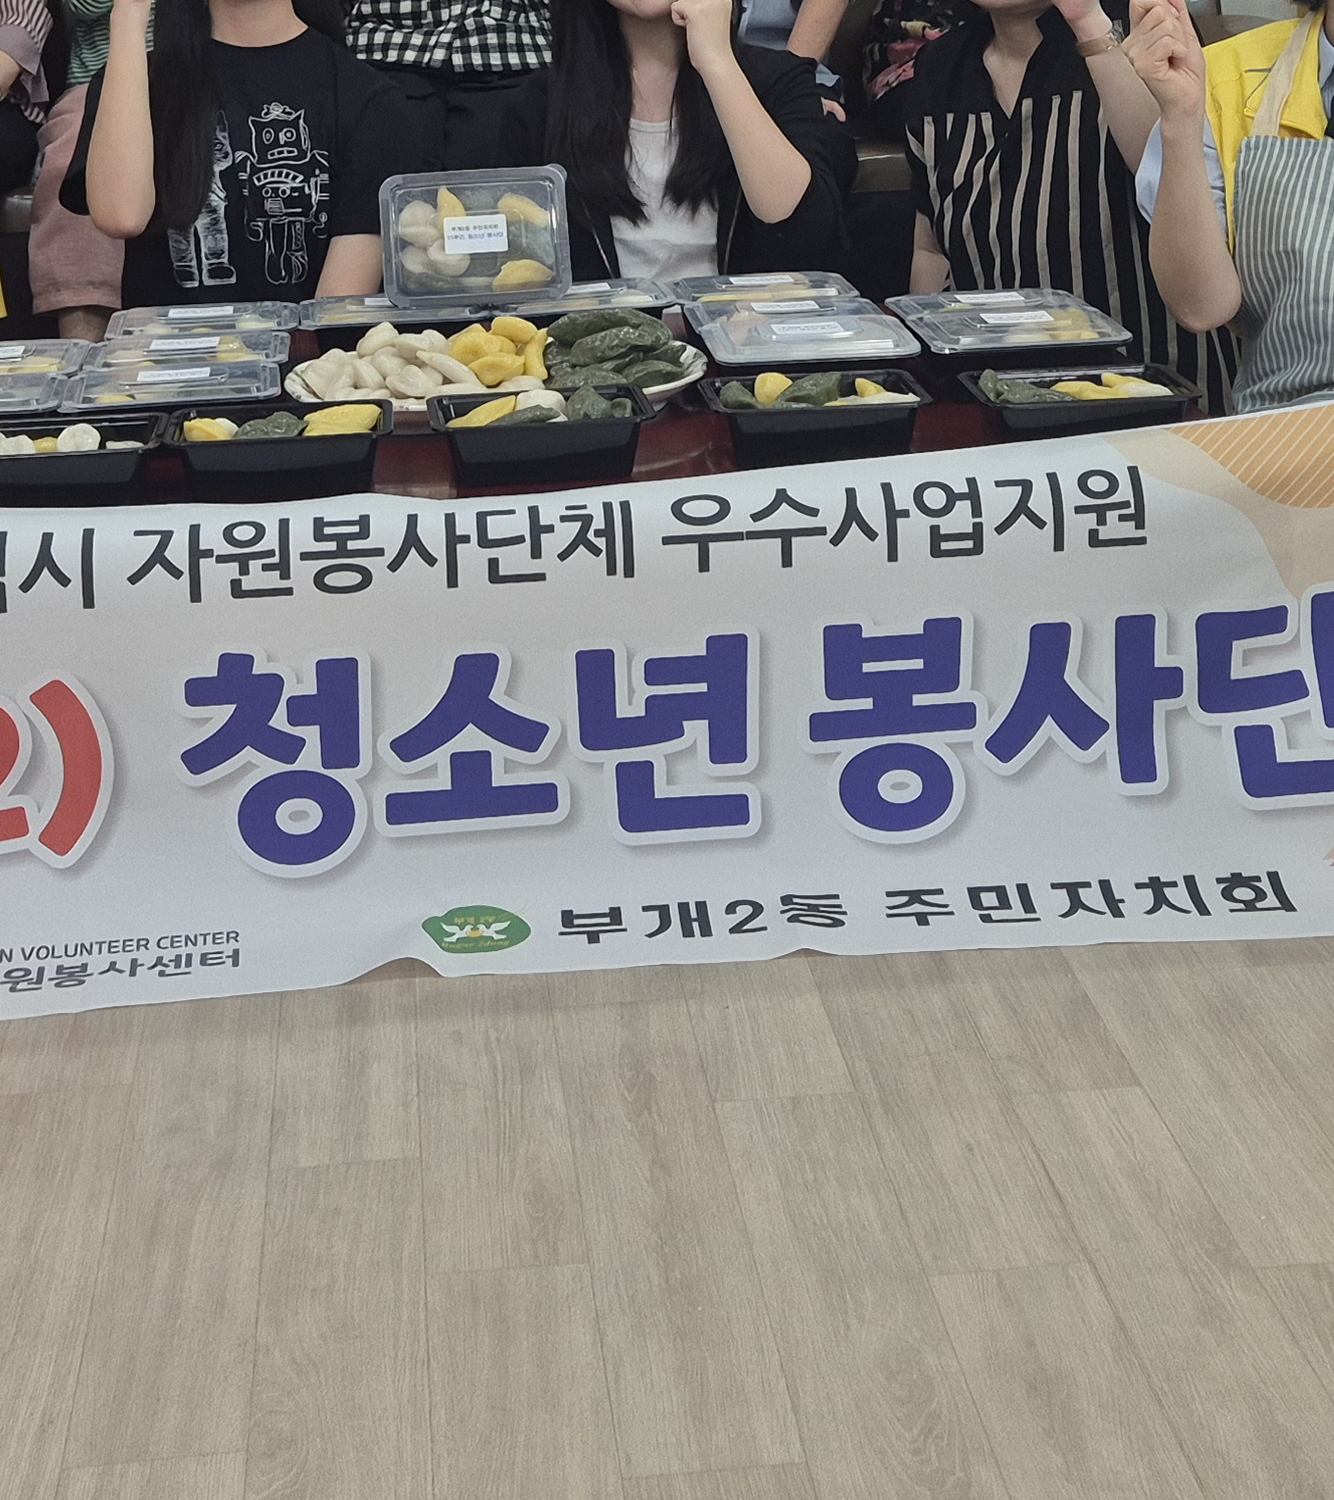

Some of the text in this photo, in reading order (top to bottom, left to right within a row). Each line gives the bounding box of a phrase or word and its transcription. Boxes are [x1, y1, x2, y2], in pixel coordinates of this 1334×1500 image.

[127, 505, 634, 604] 자원봉사단체
[661, 468, 1148, 573] 우수사업지원
[180, 632, 751, 866] 청소년
[20, 937, 151, 963] VOLUNTEER
[156, 930, 240, 953] CENTER
[559, 870, 1298, 945] 부개2동 주민자치회
